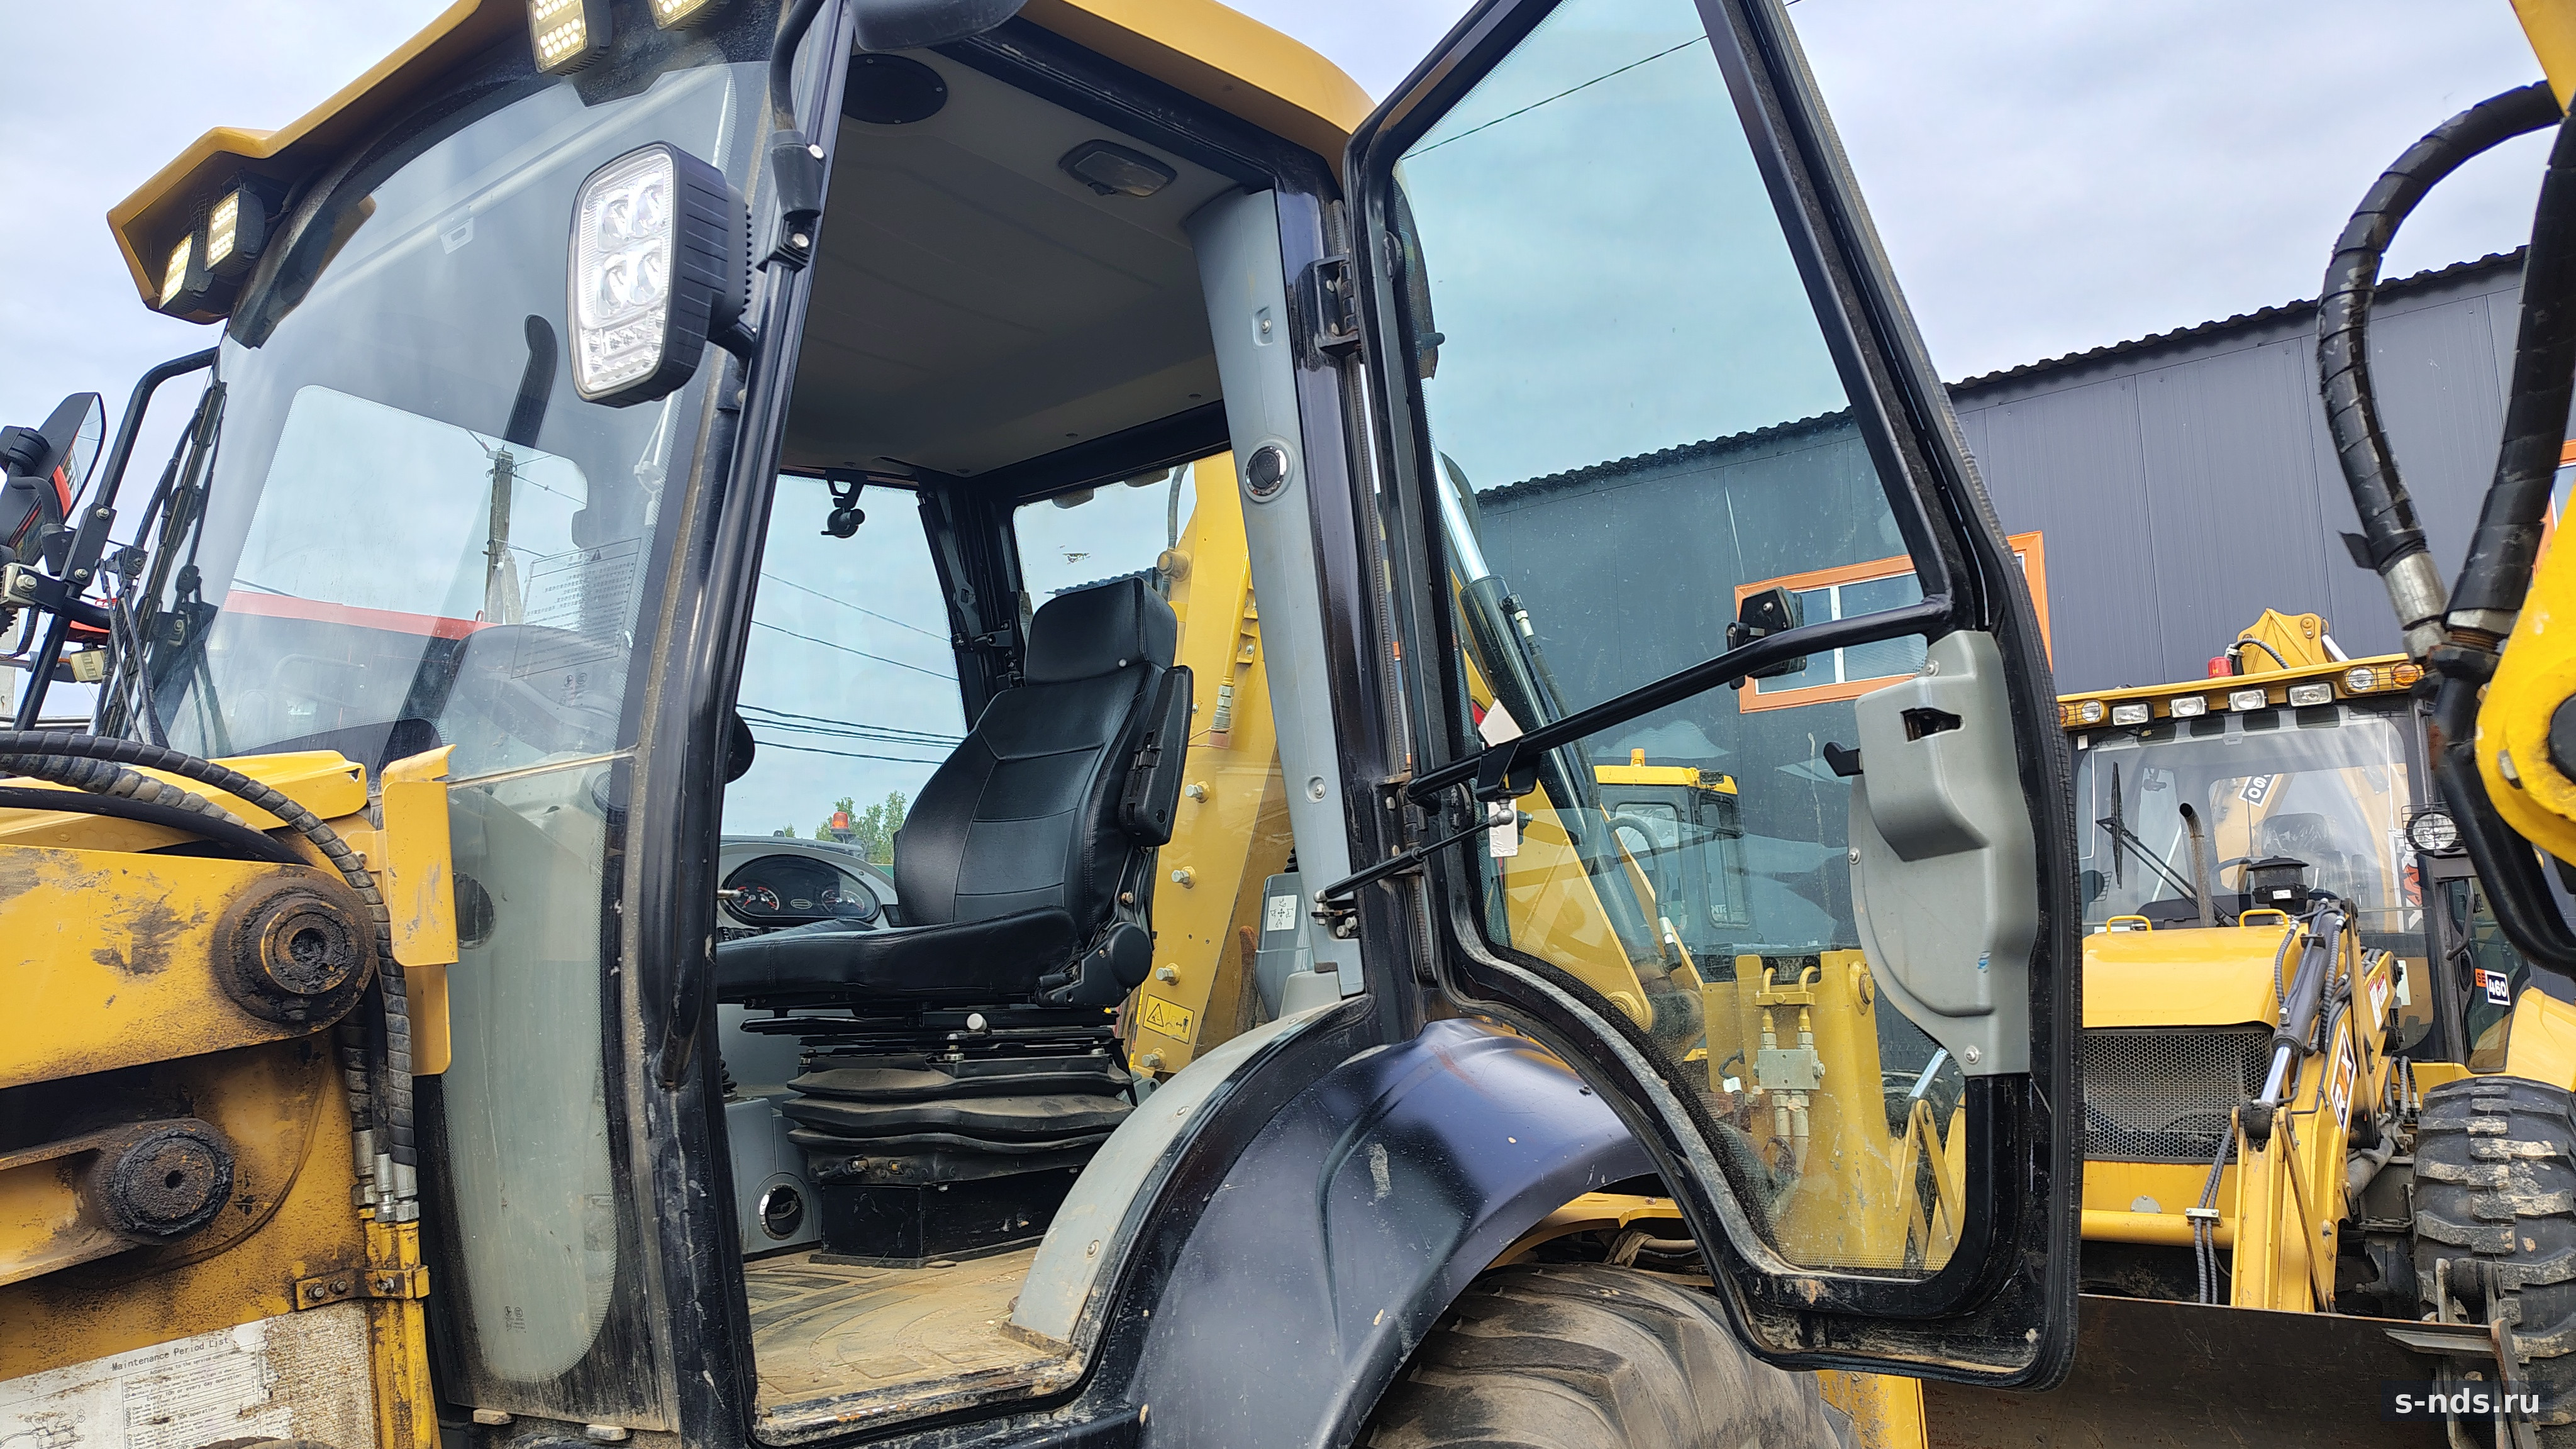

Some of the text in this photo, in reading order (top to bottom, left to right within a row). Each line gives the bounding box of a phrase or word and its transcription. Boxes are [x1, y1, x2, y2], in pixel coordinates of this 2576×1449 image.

[2489, 979, 2507, 997] 460
[112, 1336, 229, 1371] Maintenance Period List
[150, 1366, 174, 1375] According
[216, 1374, 242, 1384] operation
[189, 1406, 218, 1417] operation
